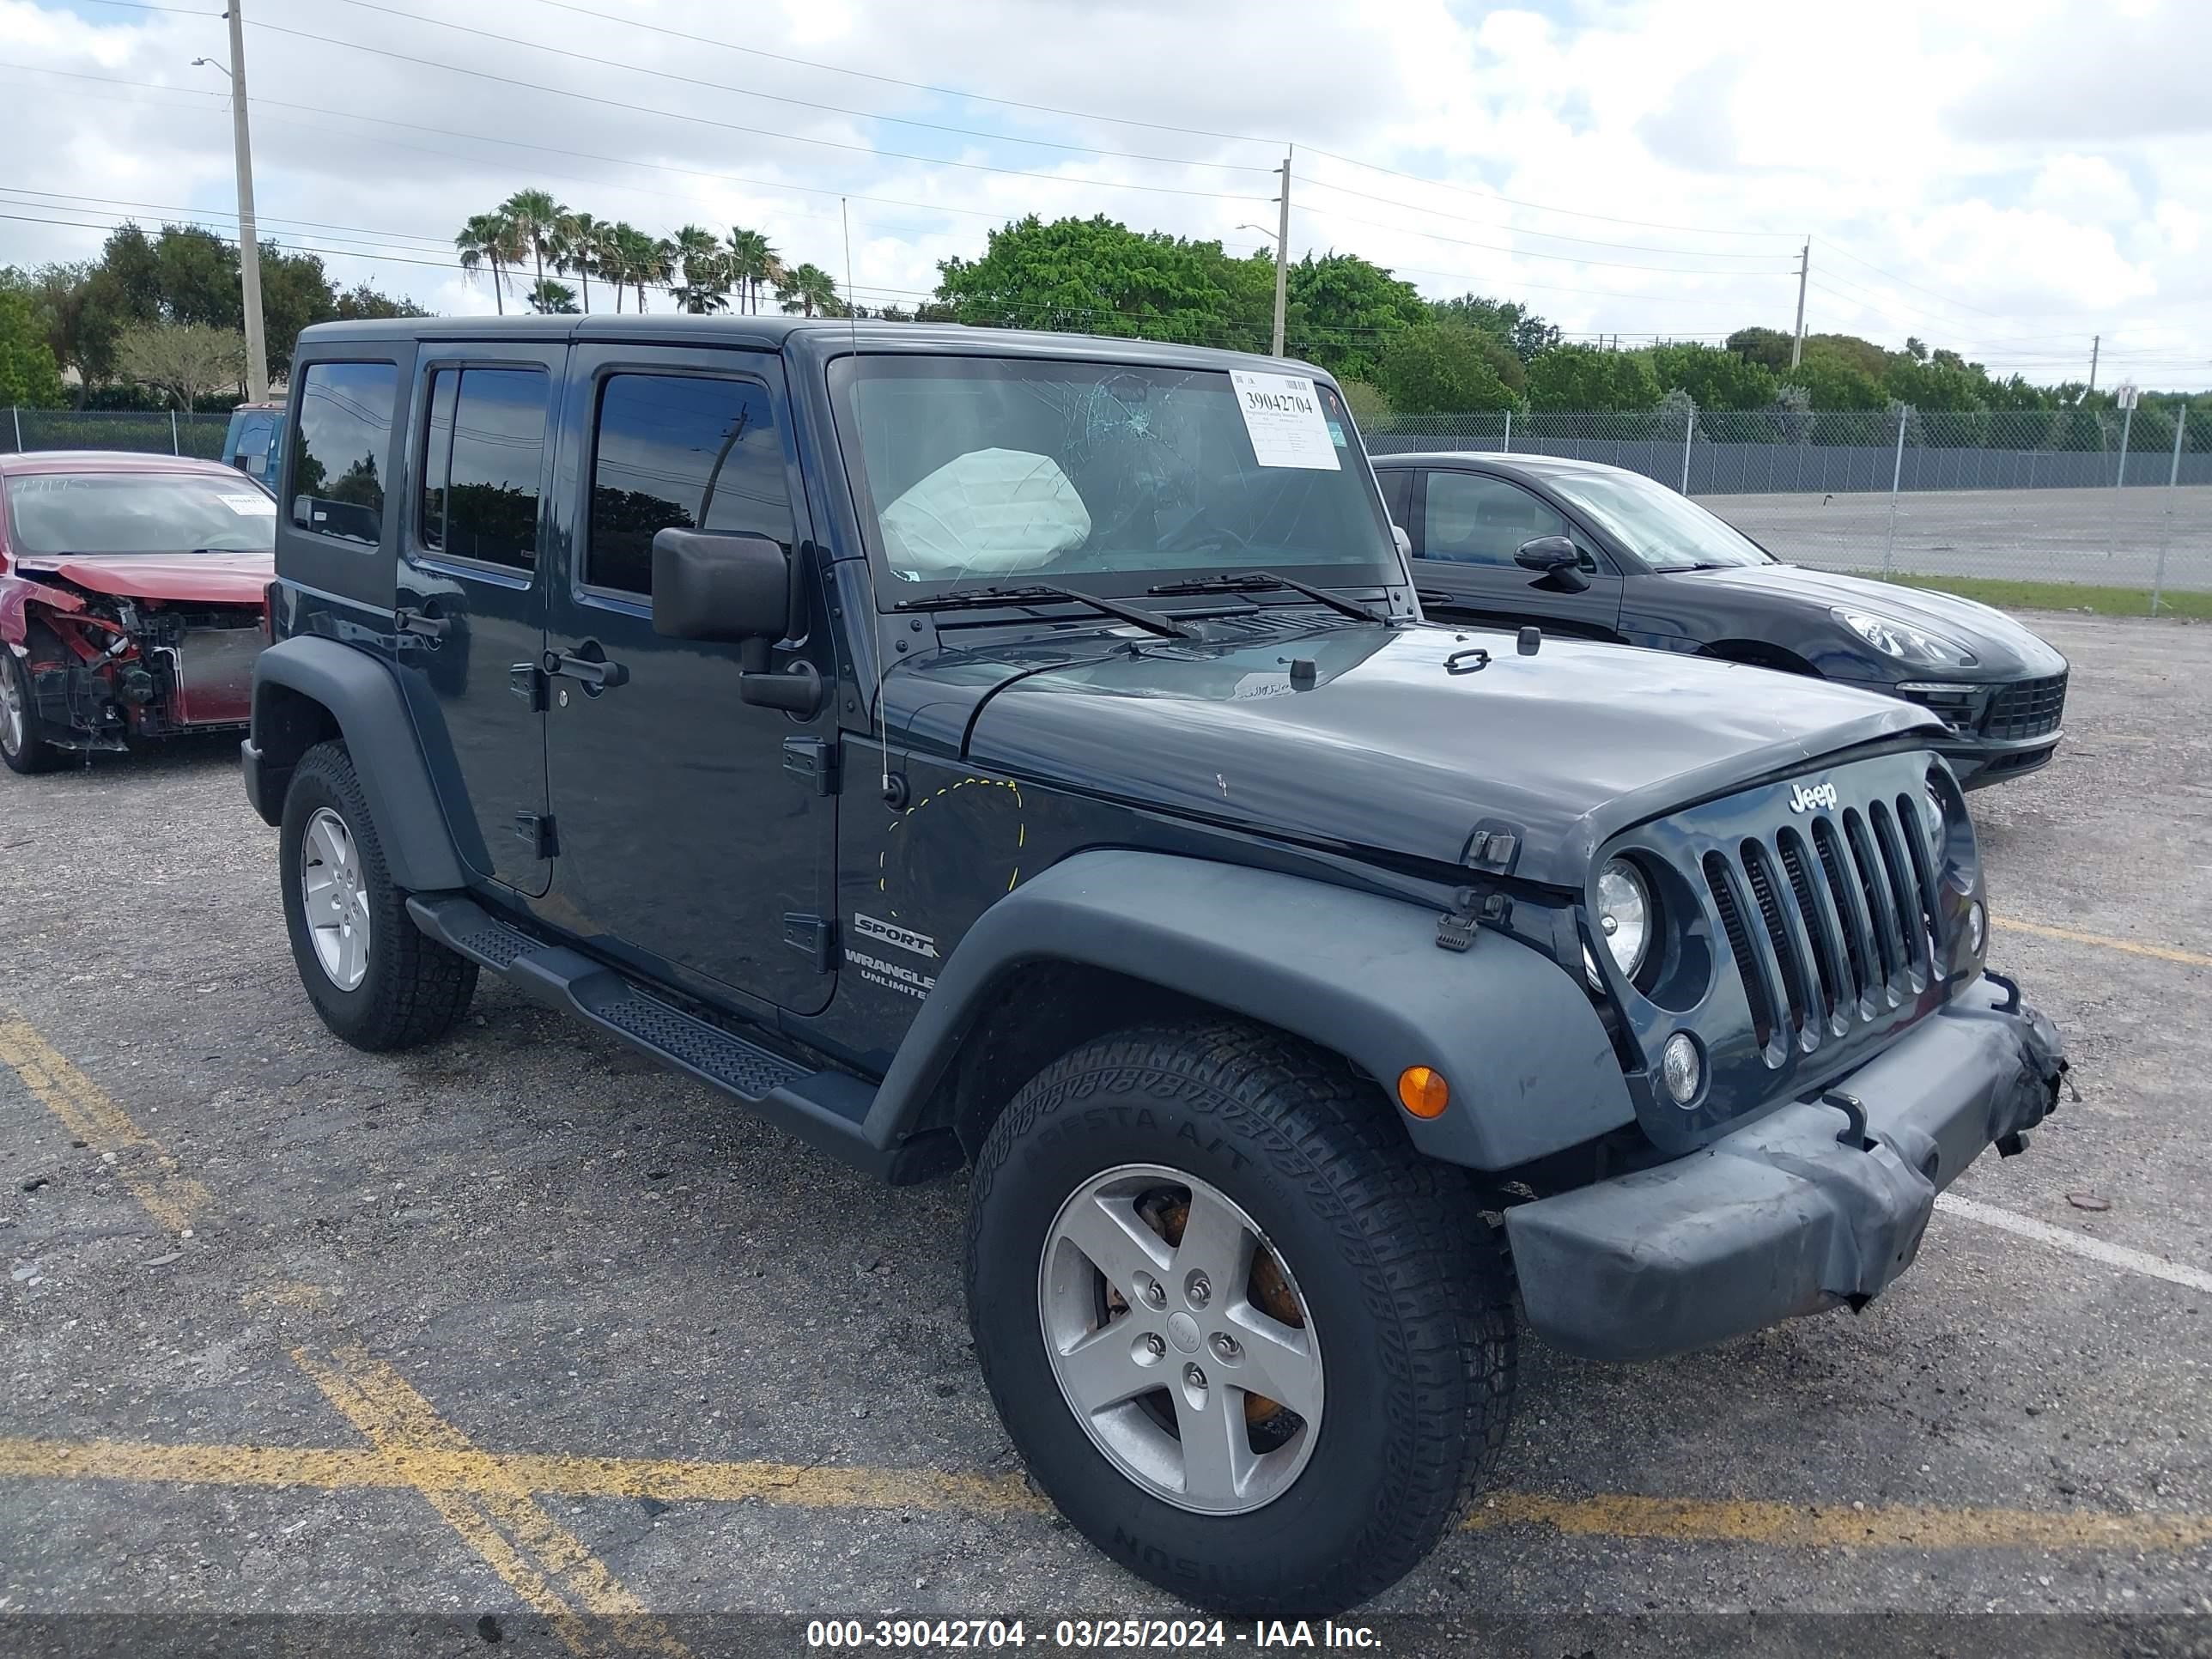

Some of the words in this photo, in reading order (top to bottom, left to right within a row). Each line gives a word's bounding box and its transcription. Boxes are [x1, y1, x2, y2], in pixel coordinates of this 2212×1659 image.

[1246, 392, 1312, 414] 39042704
[1789, 782, 1838, 813] Jeep
[855, 919, 934, 951] SPORT
[845, 948, 936, 989] WRANGLE
[860, 969, 930, 1000] UNLIMITE
